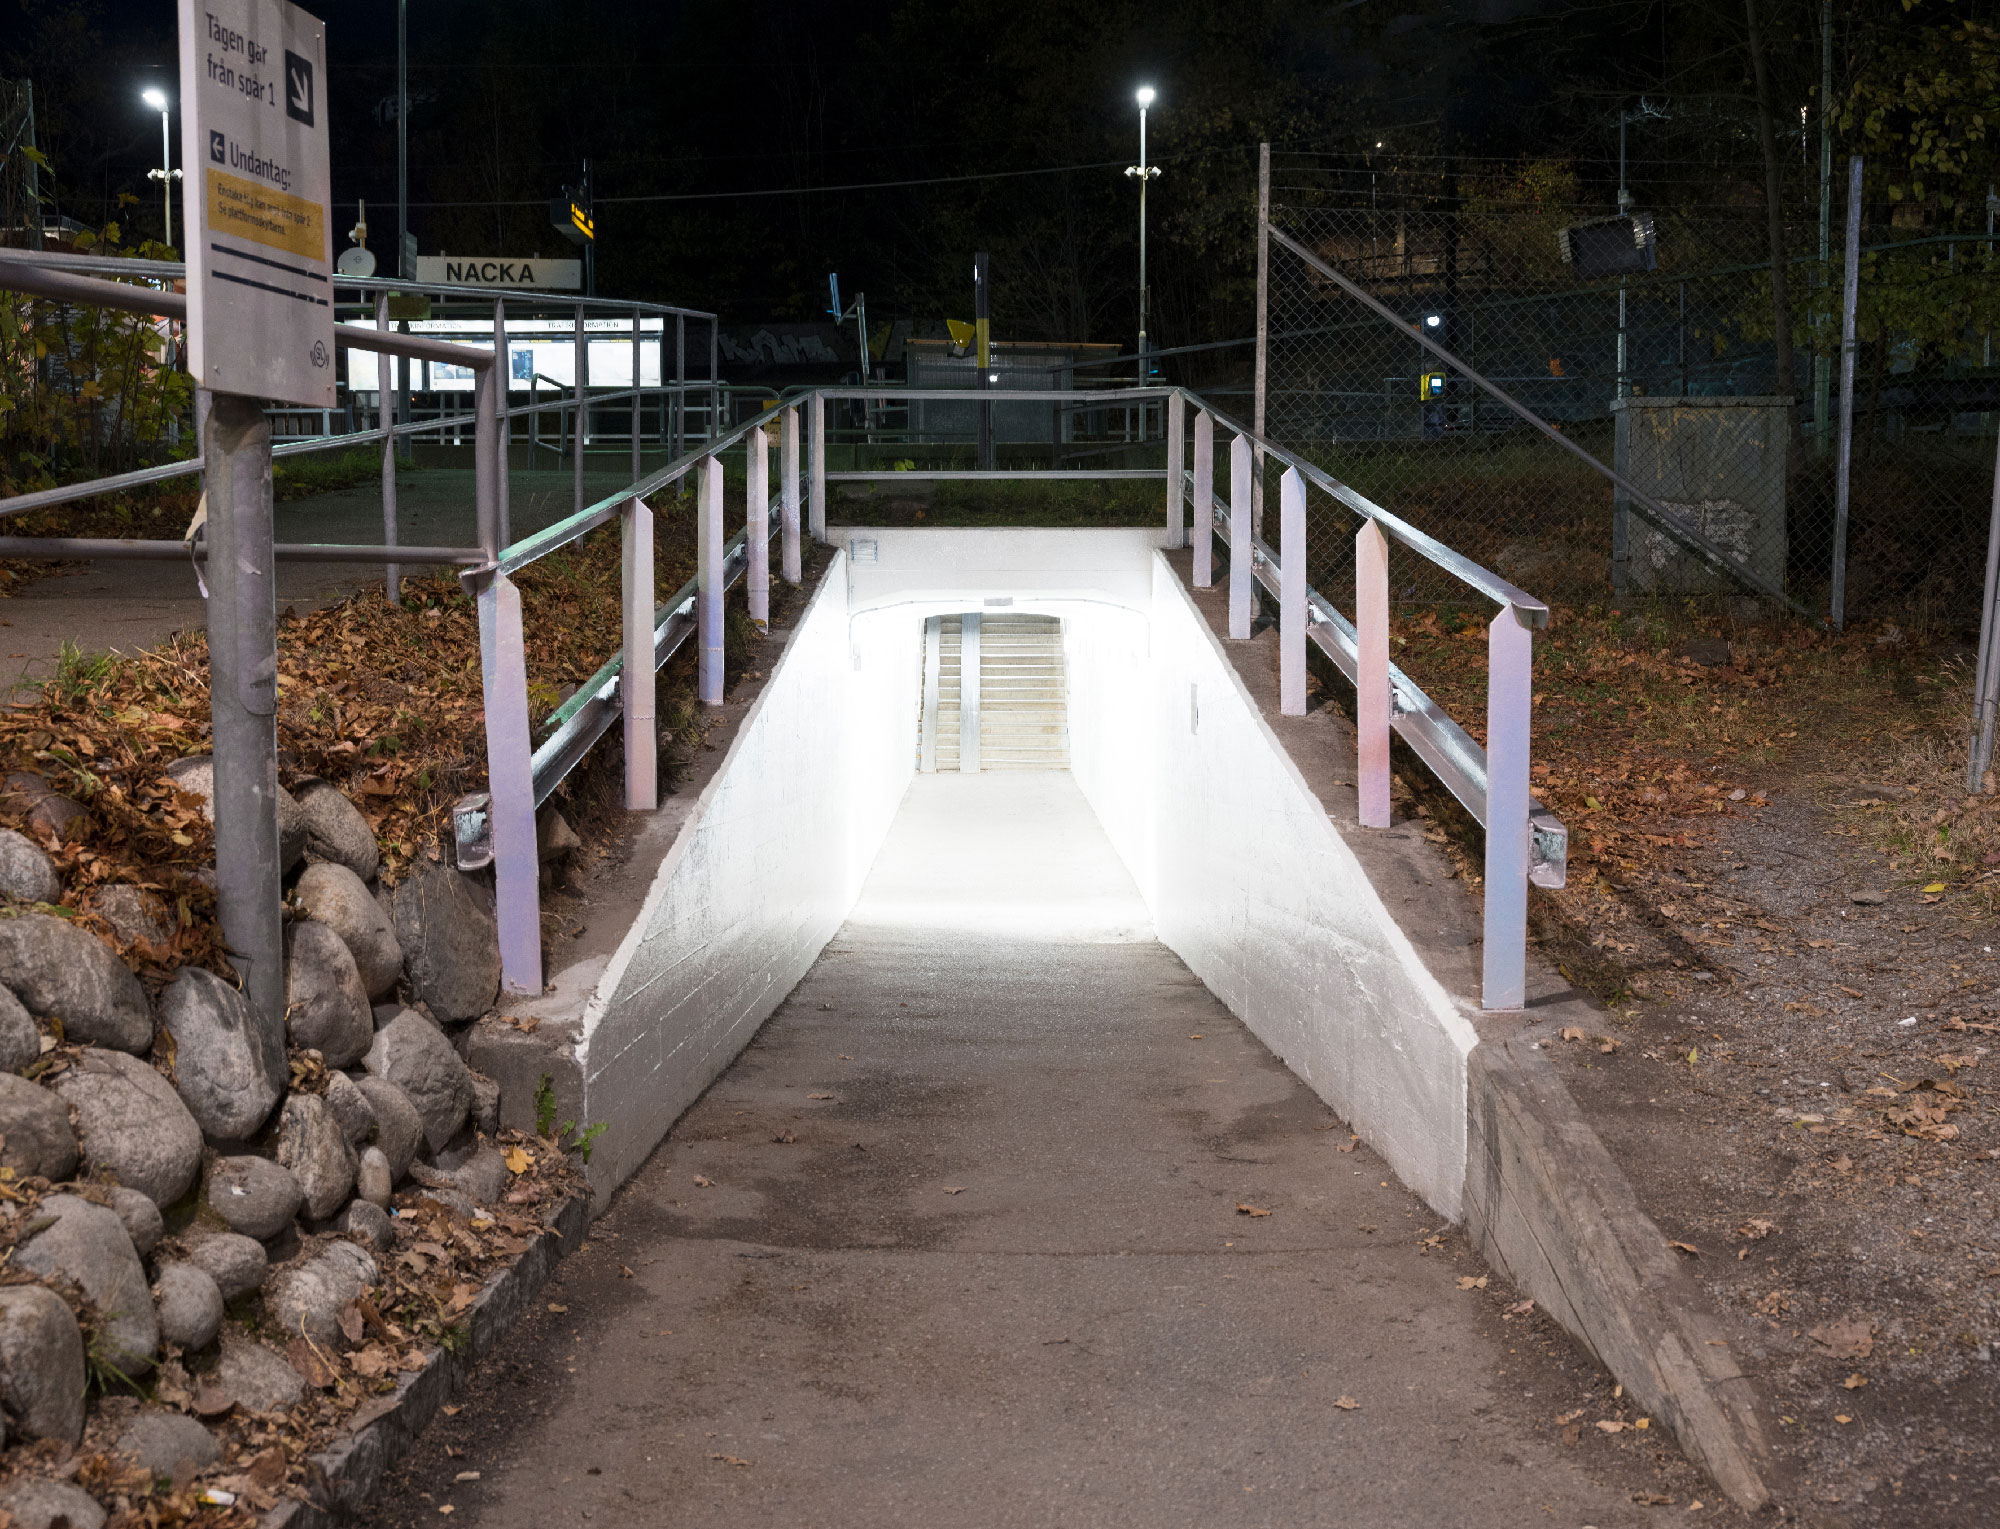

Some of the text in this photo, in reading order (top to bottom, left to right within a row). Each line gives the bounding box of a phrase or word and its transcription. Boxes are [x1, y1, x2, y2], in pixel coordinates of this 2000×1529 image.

[206, 12, 268, 65] Tågen går
[207, 53, 276, 107] från spår 1
[230, 142, 292, 191] Undantag:
[446, 262, 535, 283] NACKA
